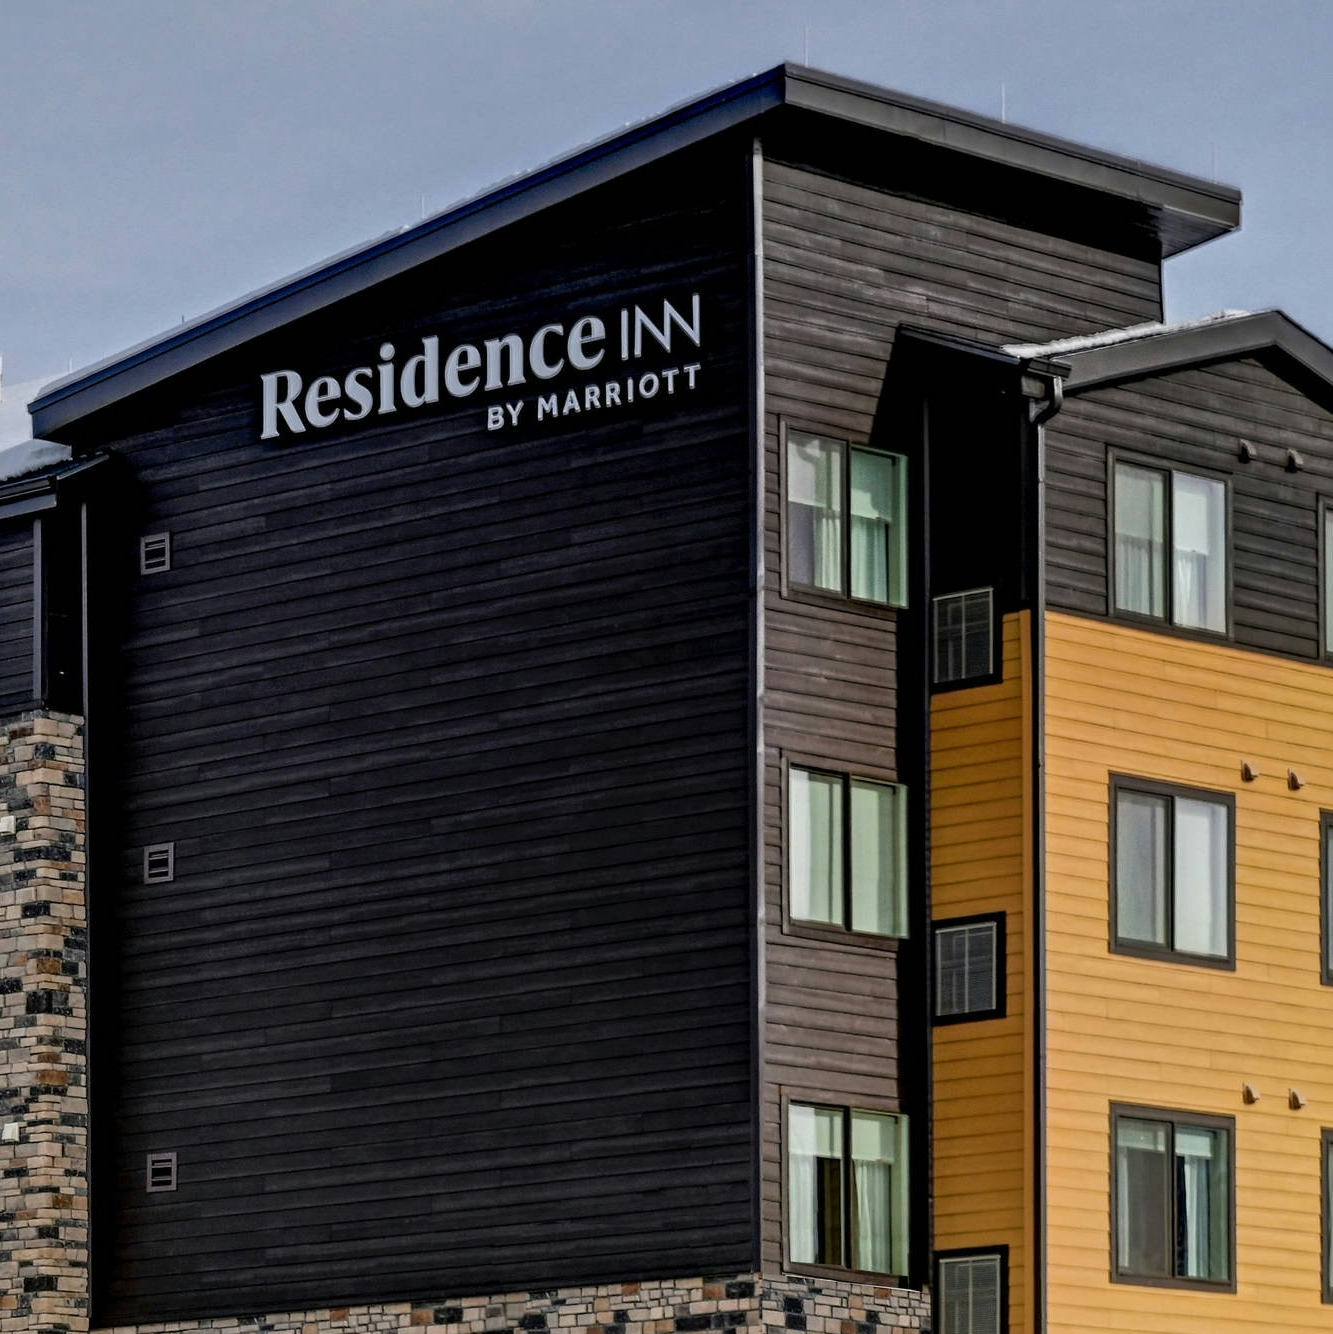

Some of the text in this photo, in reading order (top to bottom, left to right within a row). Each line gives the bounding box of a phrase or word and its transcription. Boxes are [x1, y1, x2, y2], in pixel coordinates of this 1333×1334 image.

[260, 293, 701, 440] Residence INN
[487, 363, 701, 431] BY MARRIOTT
